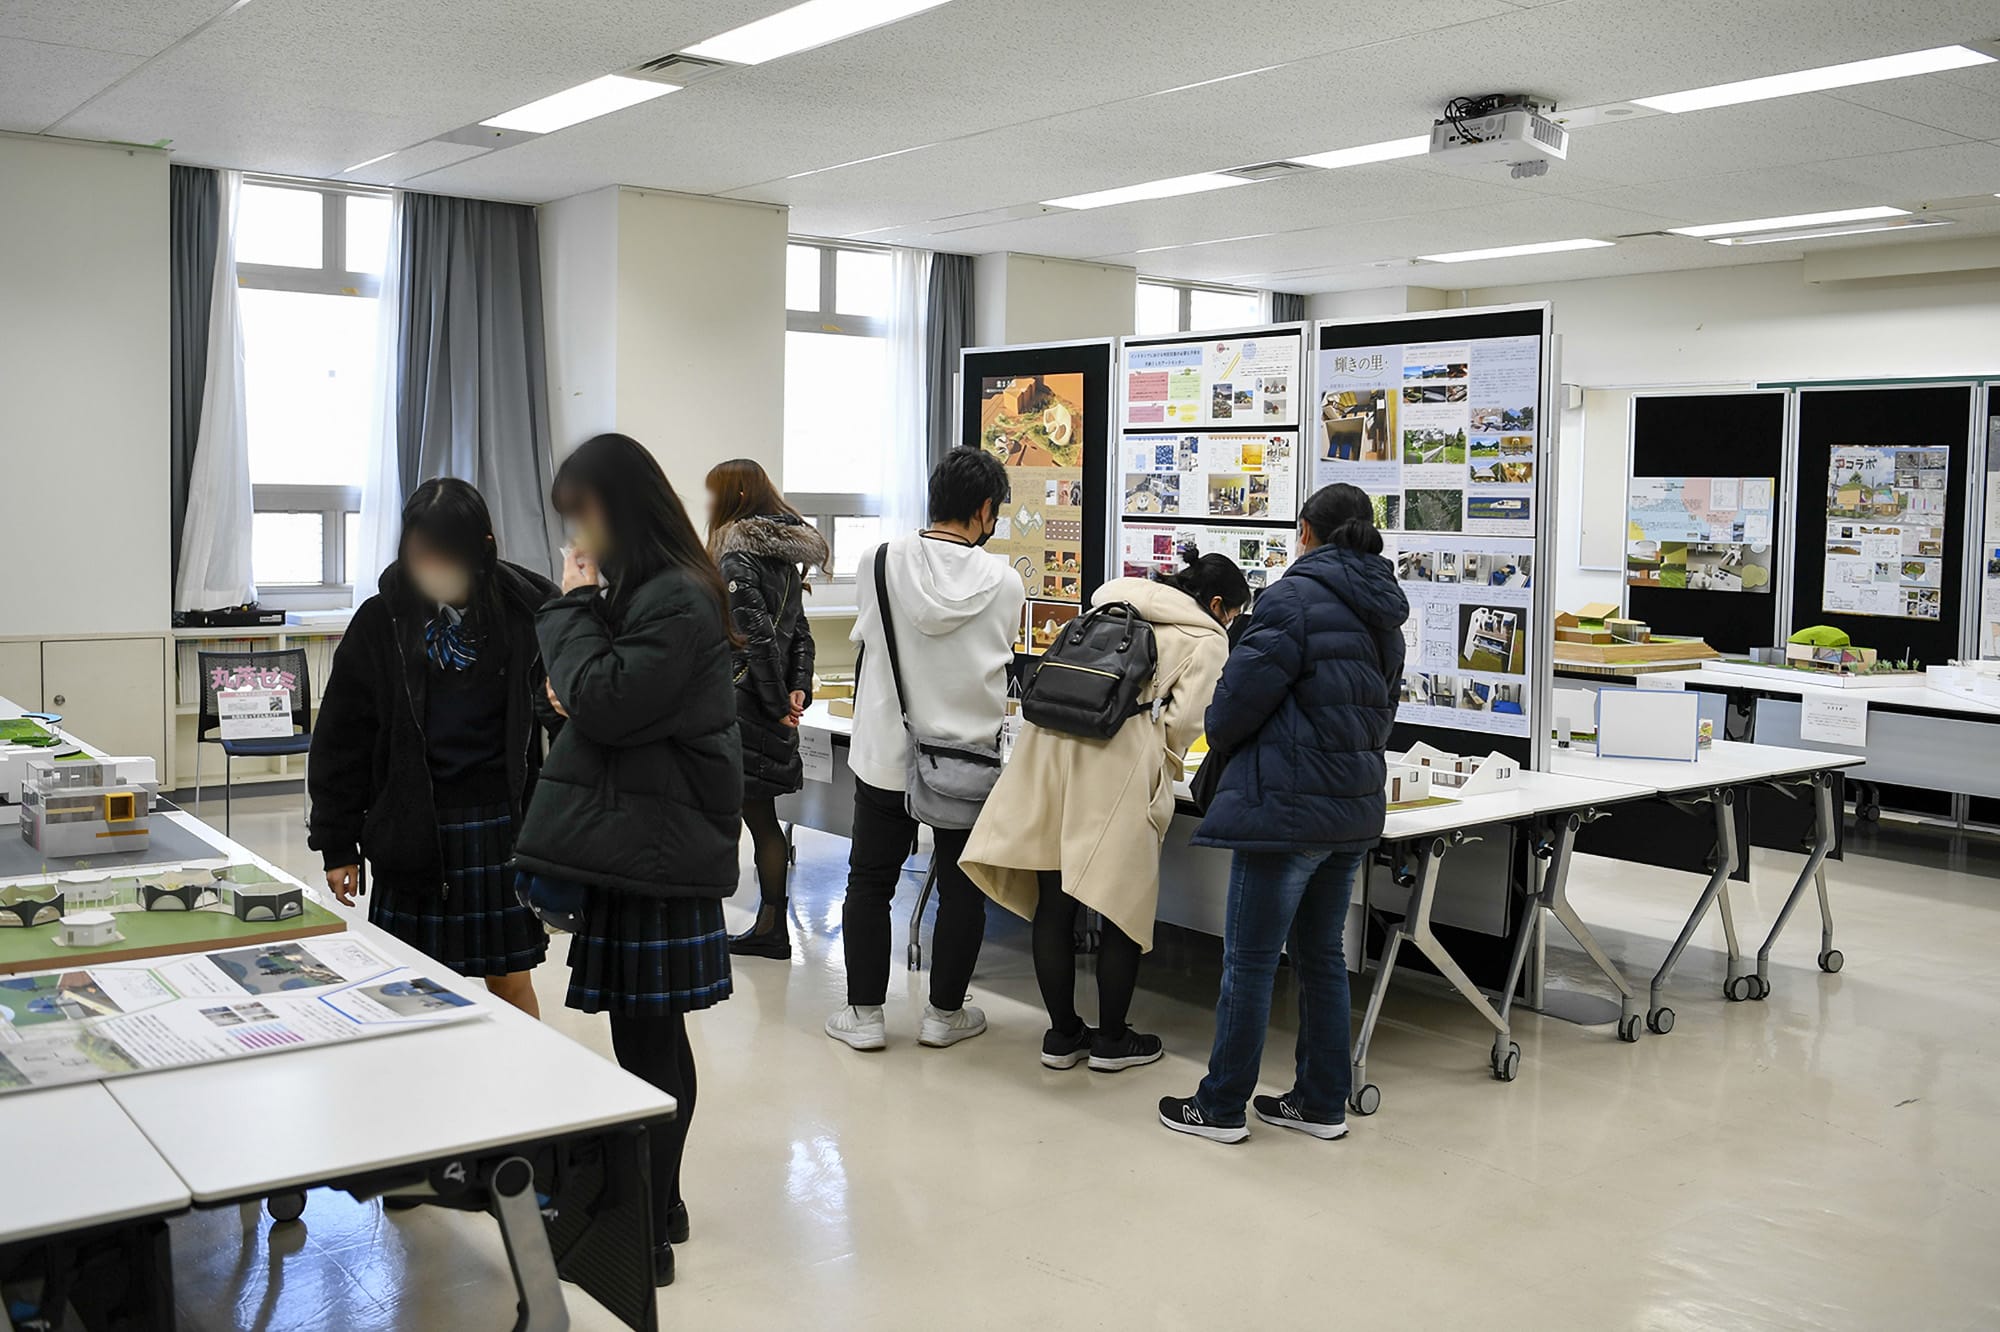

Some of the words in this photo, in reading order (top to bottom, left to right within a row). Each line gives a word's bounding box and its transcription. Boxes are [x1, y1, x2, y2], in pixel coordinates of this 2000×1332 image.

[1334, 354, 1383, 373] 輝きの里
[210, 666, 297, 691] 丸茂ゼミ
